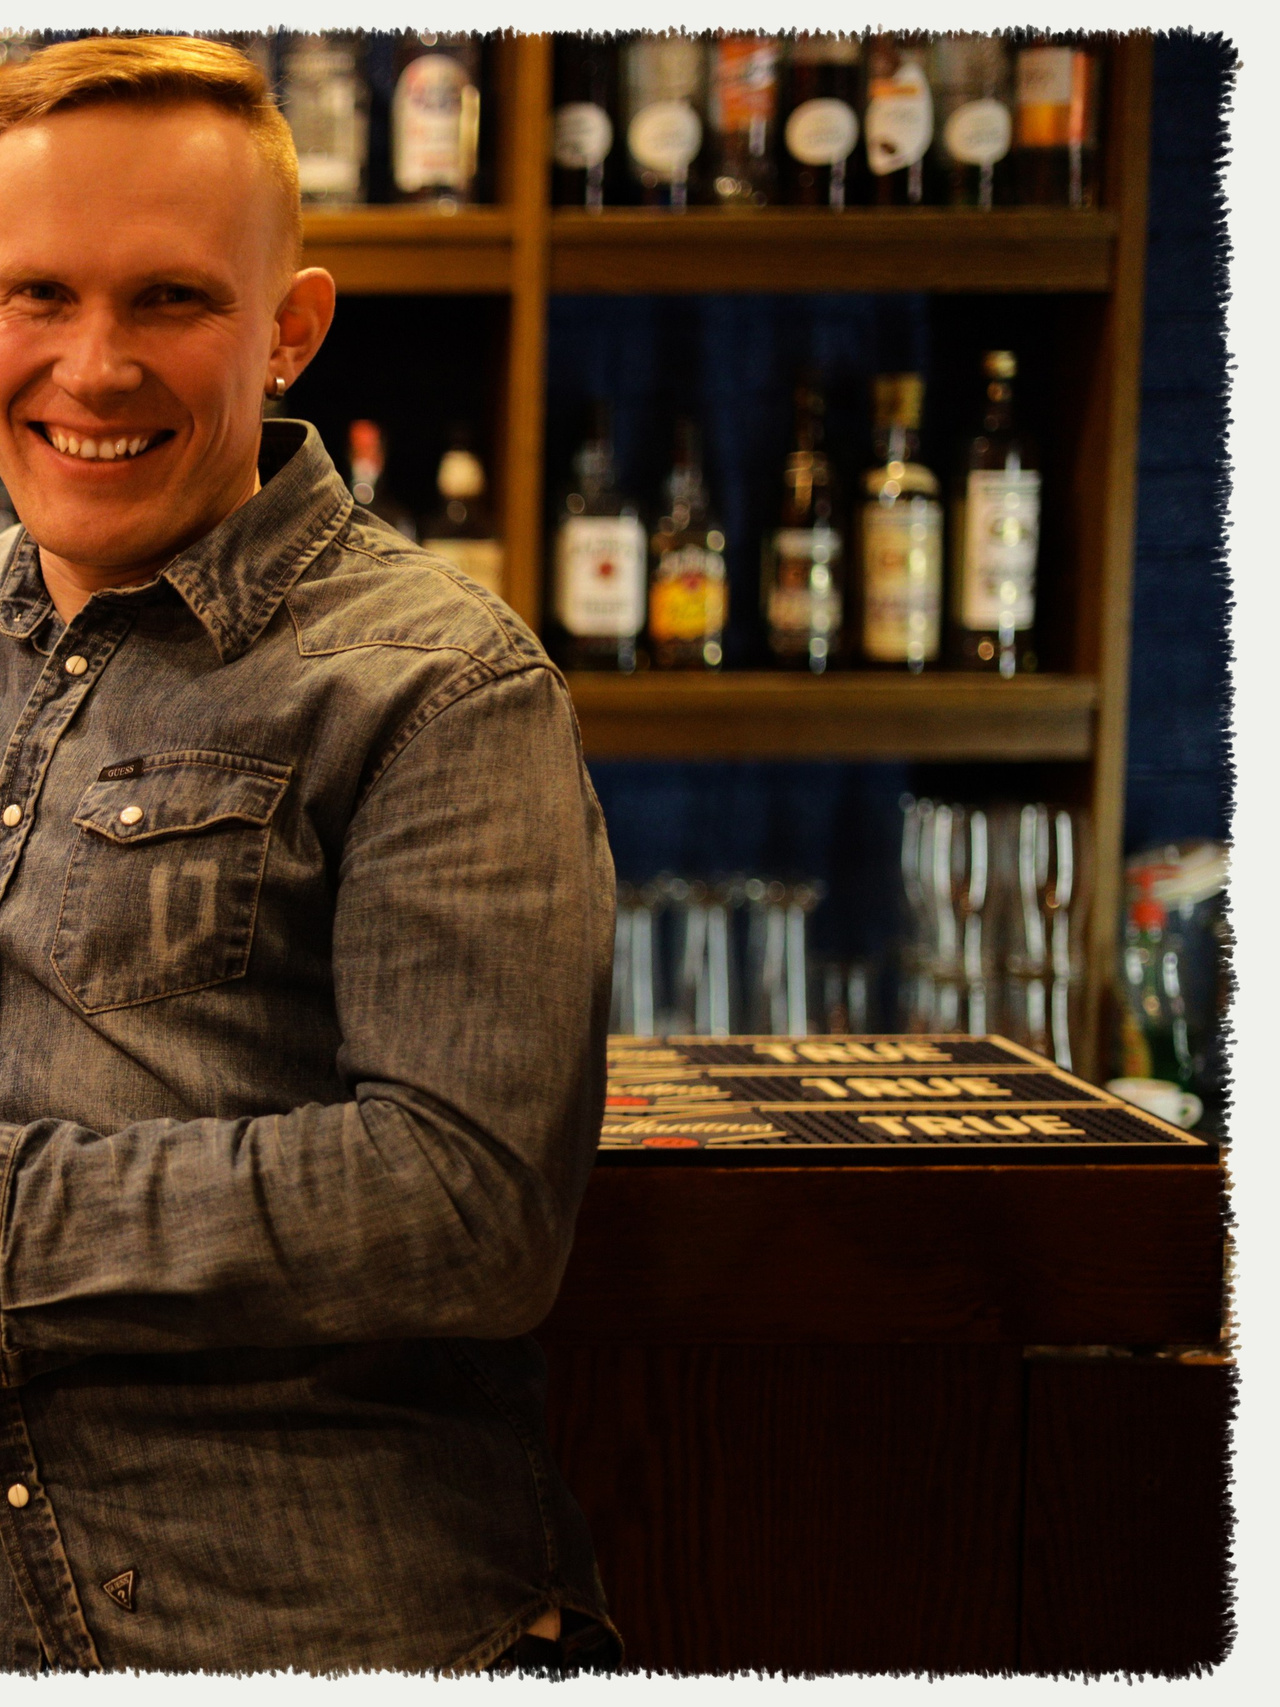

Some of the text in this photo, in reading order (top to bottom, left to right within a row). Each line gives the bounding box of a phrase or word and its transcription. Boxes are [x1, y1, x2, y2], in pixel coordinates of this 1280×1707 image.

[107, 764, 135, 778] GUESS
[753, 1043, 953, 1064] TRUE
[800, 1077, 1013, 1098] TRUE
[857, 1115, 1087, 1137] TRUE
